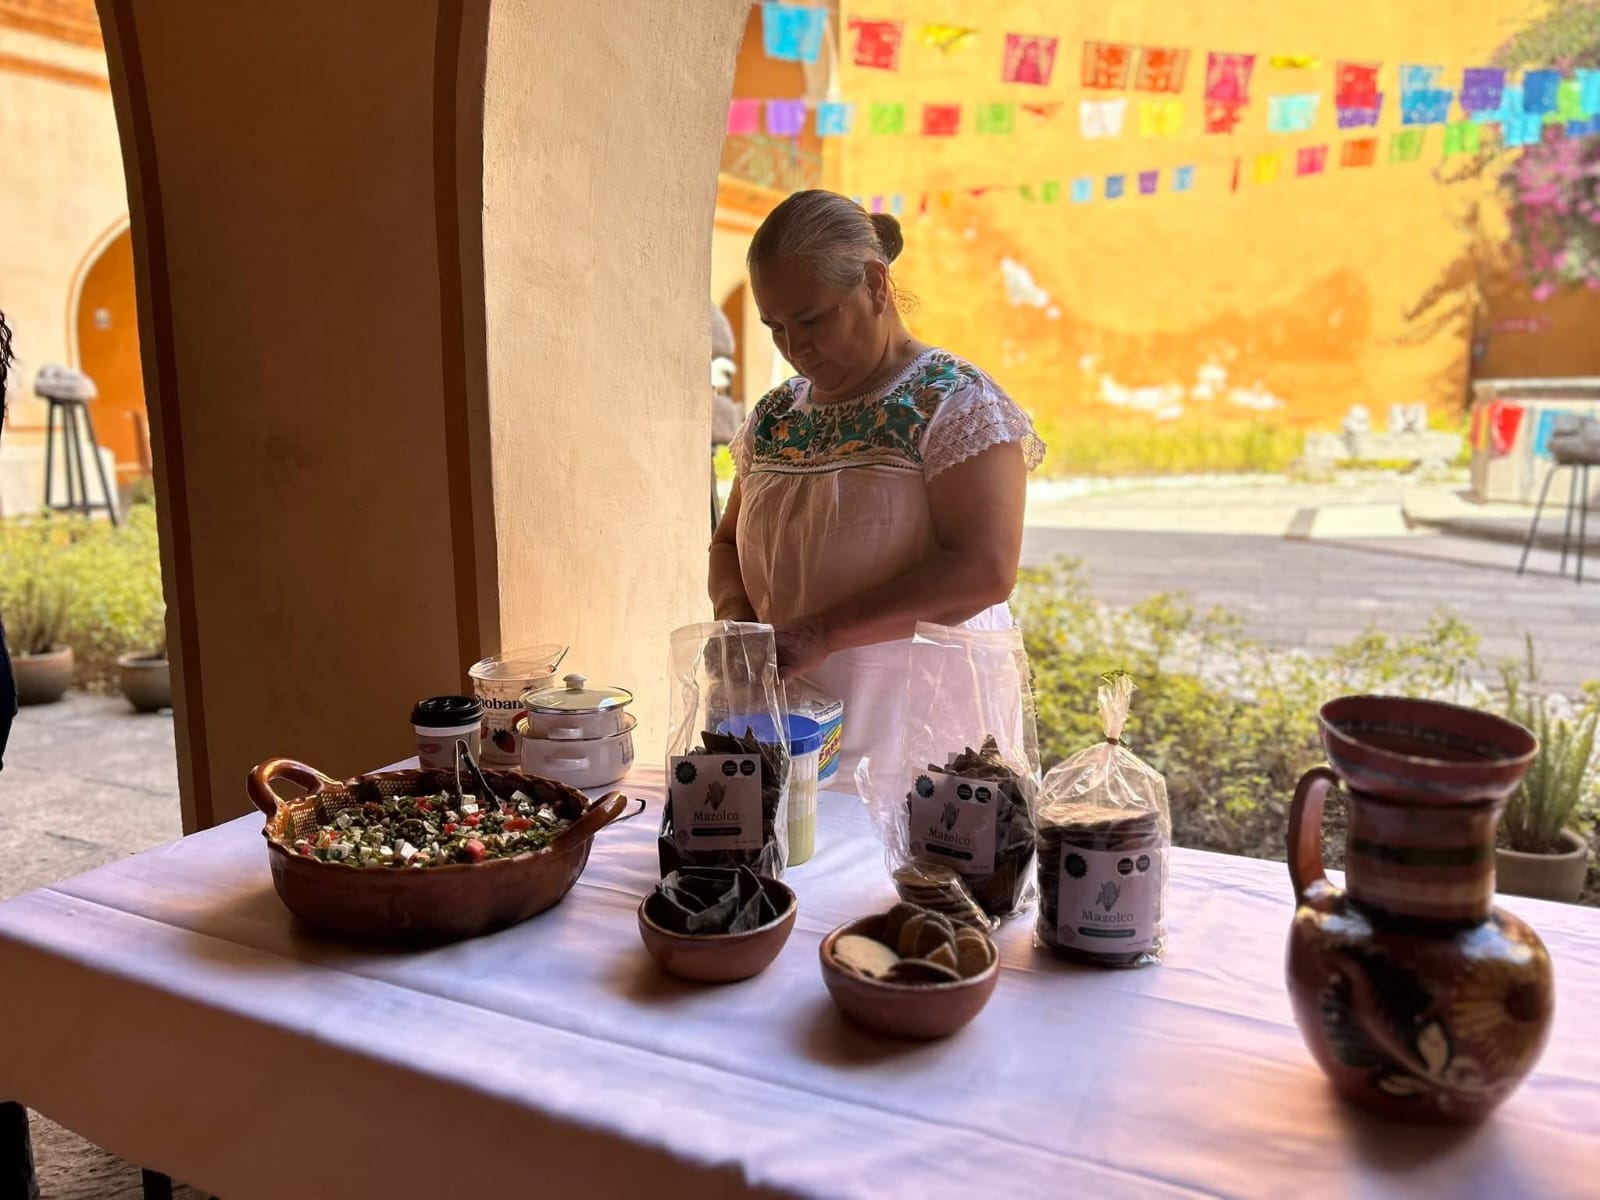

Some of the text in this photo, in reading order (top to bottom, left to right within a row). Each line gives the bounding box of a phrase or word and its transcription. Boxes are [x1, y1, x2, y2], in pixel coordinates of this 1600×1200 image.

[693, 810, 740, 822] Mazolco
[928, 826, 971, 846] Mazolco
[1081, 909, 1134, 923] Mazolco
